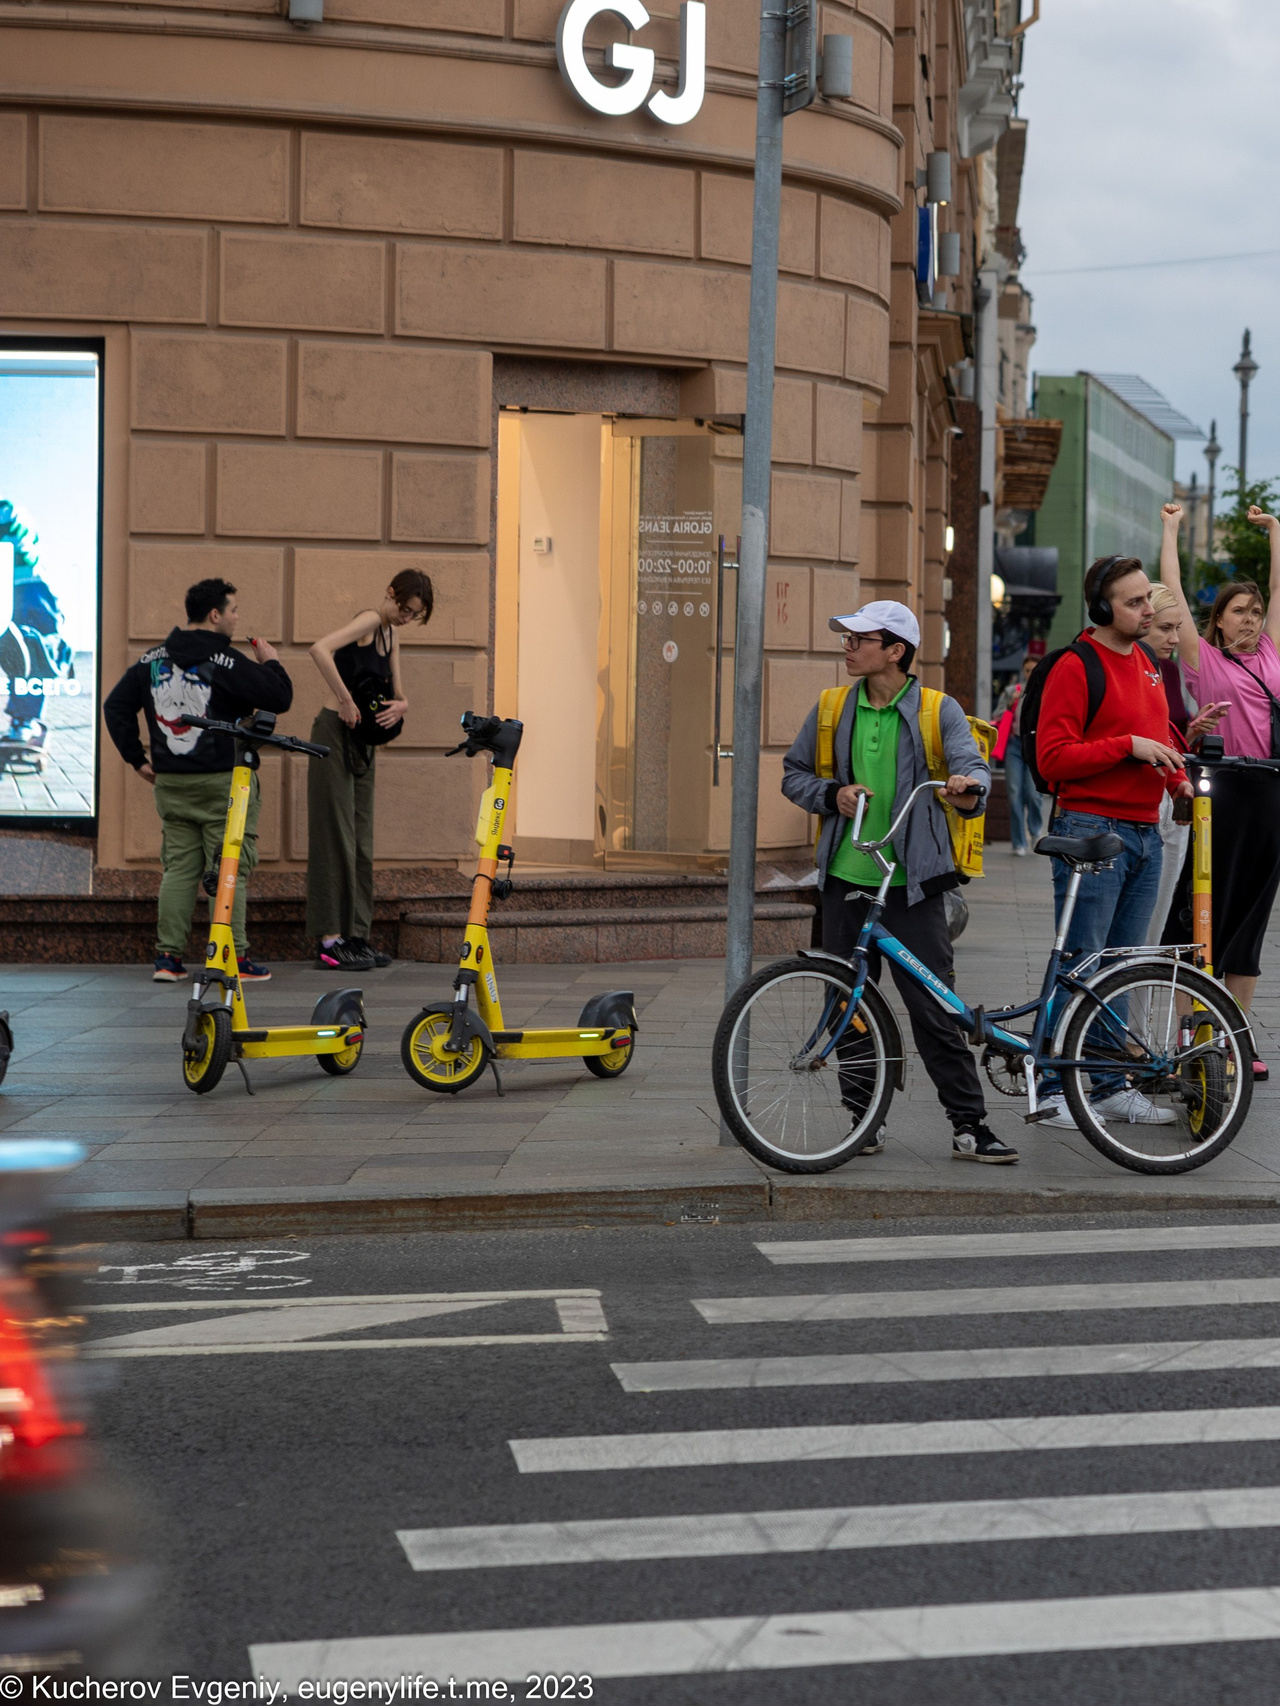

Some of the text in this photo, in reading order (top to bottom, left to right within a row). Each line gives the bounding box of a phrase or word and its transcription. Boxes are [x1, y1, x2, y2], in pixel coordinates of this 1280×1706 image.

[560, 0, 706, 125] GJ
[14, 677, 81, 697] ВСЕГО
[494, 799, 504, 810] Go
[491, 811, 502, 836] Яндекс
[897, 949, 949, 995] ДЕСНА
[485, 971, 498, 1004] SINUS
